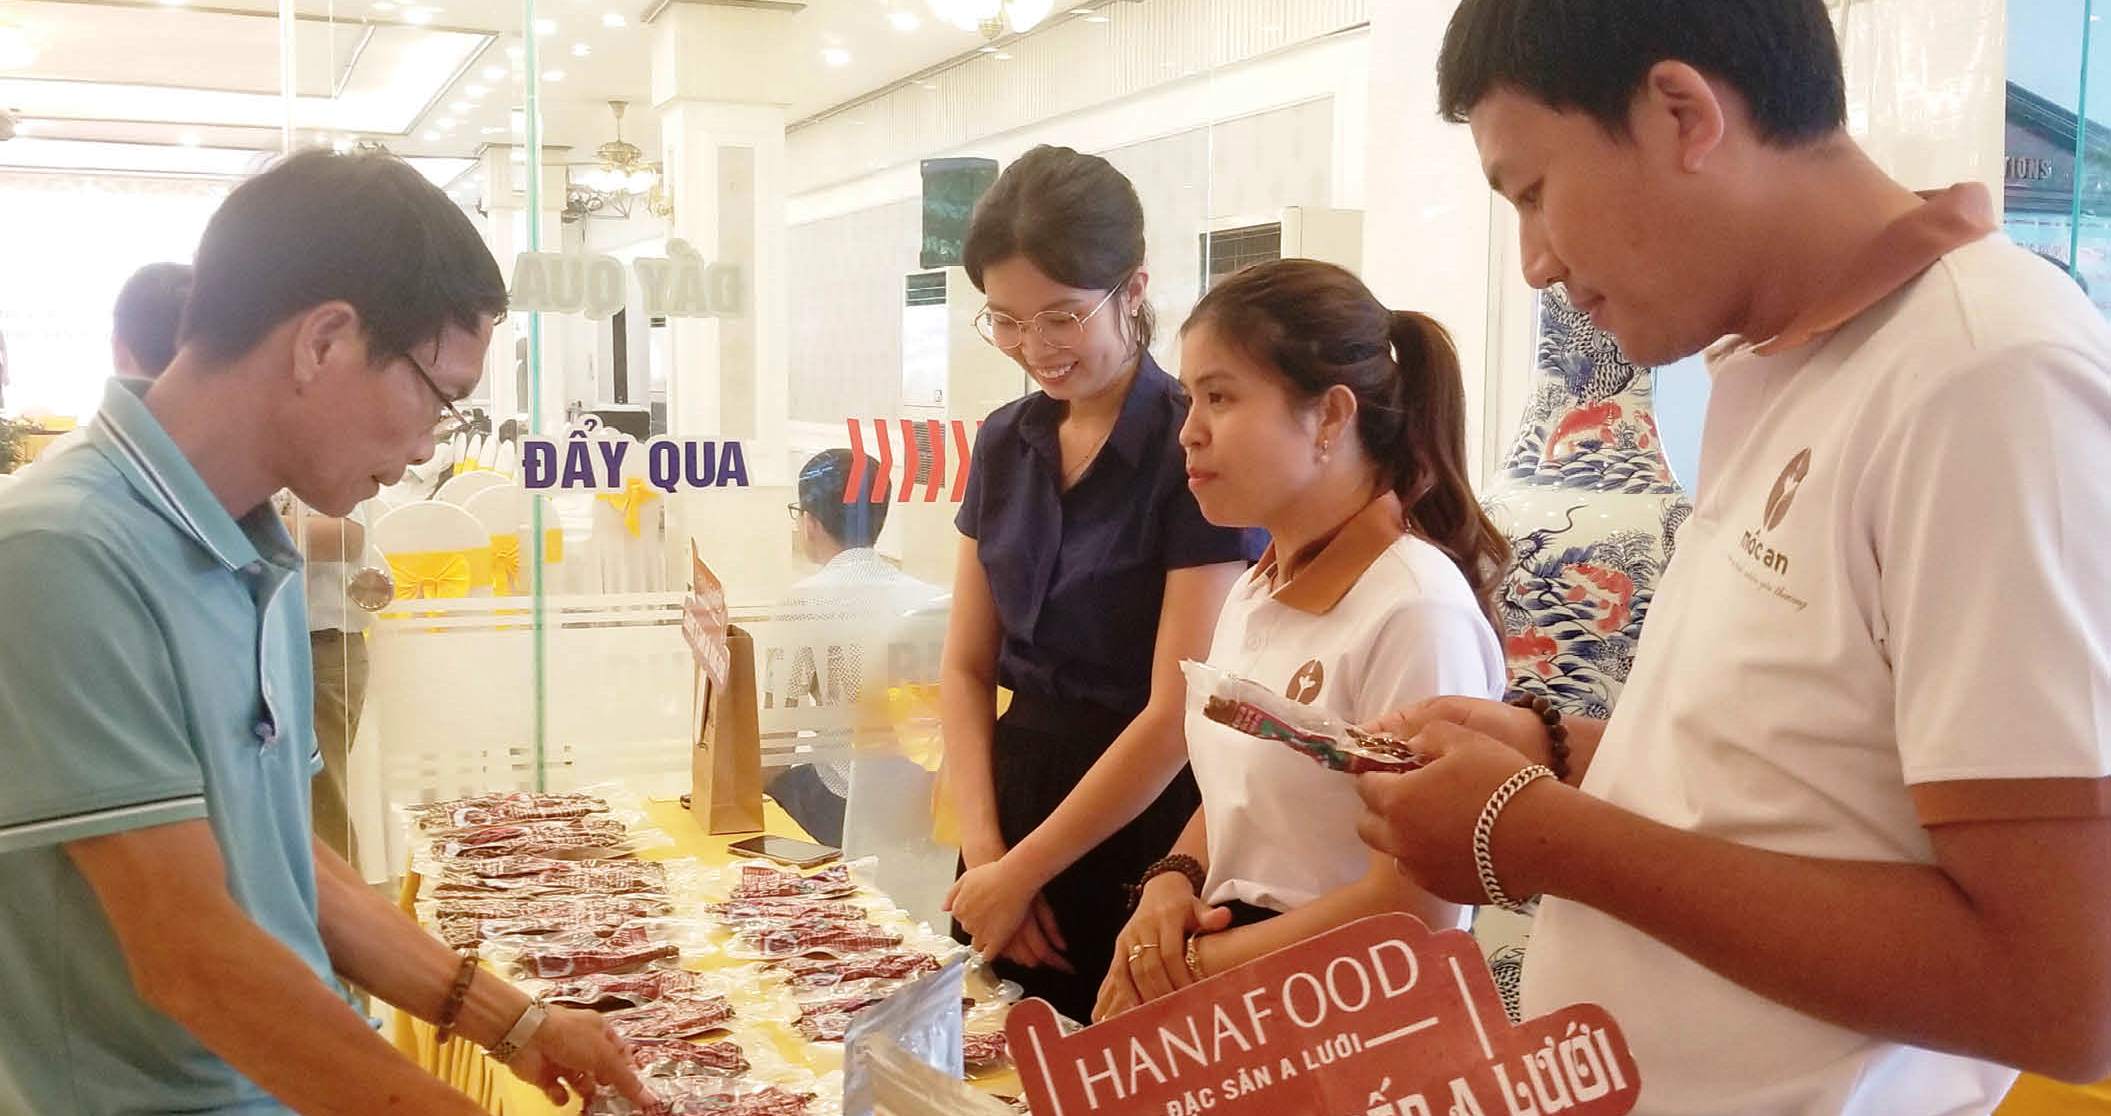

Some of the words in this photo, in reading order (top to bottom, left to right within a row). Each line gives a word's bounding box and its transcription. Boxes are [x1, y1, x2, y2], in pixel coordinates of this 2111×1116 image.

[522, 418, 628, 489] ĐẨY
[648, 440, 749, 494] QUA
[1763, 548, 1788, 575] an
[1076, 938, 1419, 1110] HANAFOOD
[1280, 1057, 1298, 1081] A
[1492, 1021, 1627, 1116] LƯỚI
